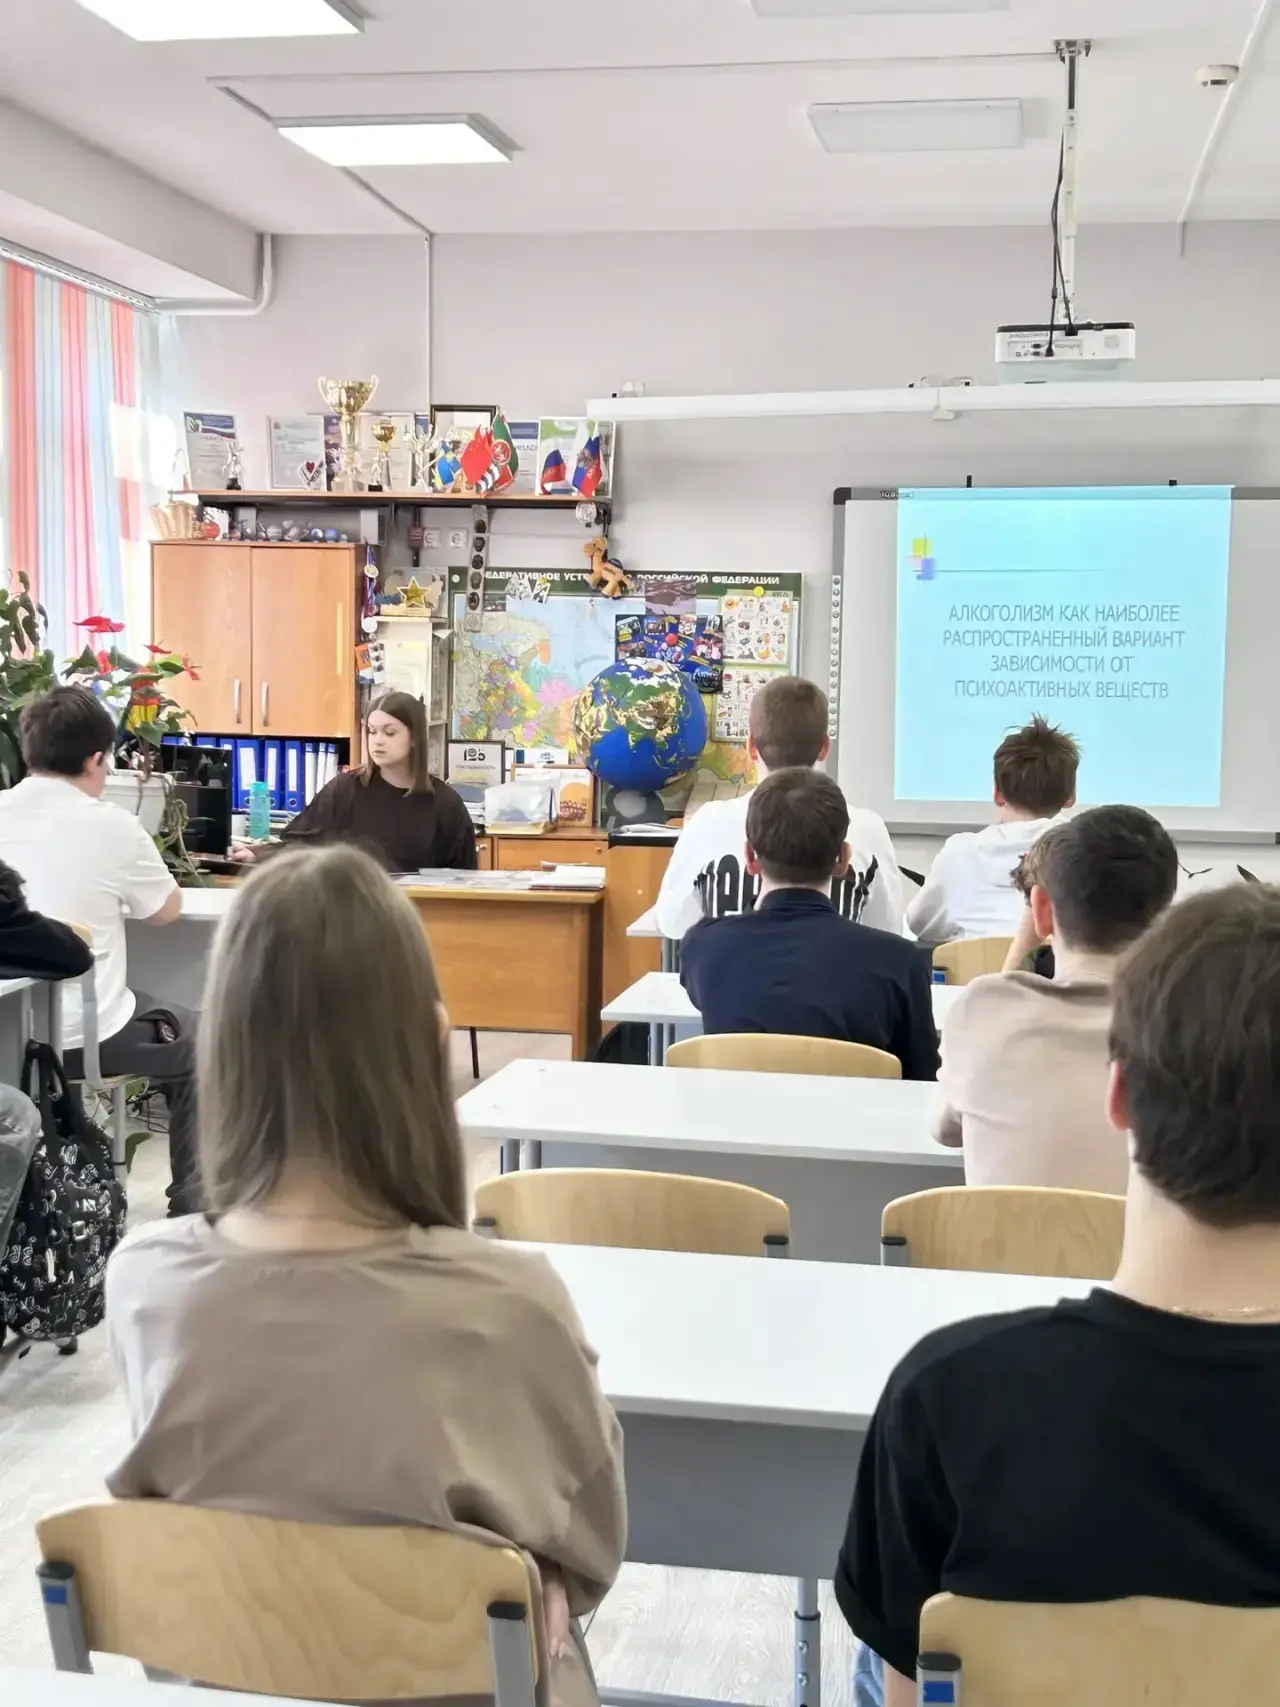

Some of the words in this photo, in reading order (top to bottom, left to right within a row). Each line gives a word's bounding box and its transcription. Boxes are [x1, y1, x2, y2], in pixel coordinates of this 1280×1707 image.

[485, 571, 561, 581] ЕДЕРАТИВНОЕ
[712, 576, 780, 585] ФЕДЕРАЦИИ
[949, 603, 1054, 622] АЛКОГОЛИЗМ
[1059, 604, 1090, 622] КАК
[1095, 604, 1181, 622] НАИБОЛЕЕ
[943, 625, 1107, 648] РАСПРОСТРАНЕННЫЙ
[1112, 630, 1186, 648] ВАРИАНТ
[990, 654, 1104, 673] ЗАВИСИМОСТИ
[1110, 656, 1135, 673] ОТ
[955, 679, 1091, 698] ПСИХОАКТИВНЫХ
[1095, 681, 1169, 701] ВЕЩЕСТВ
